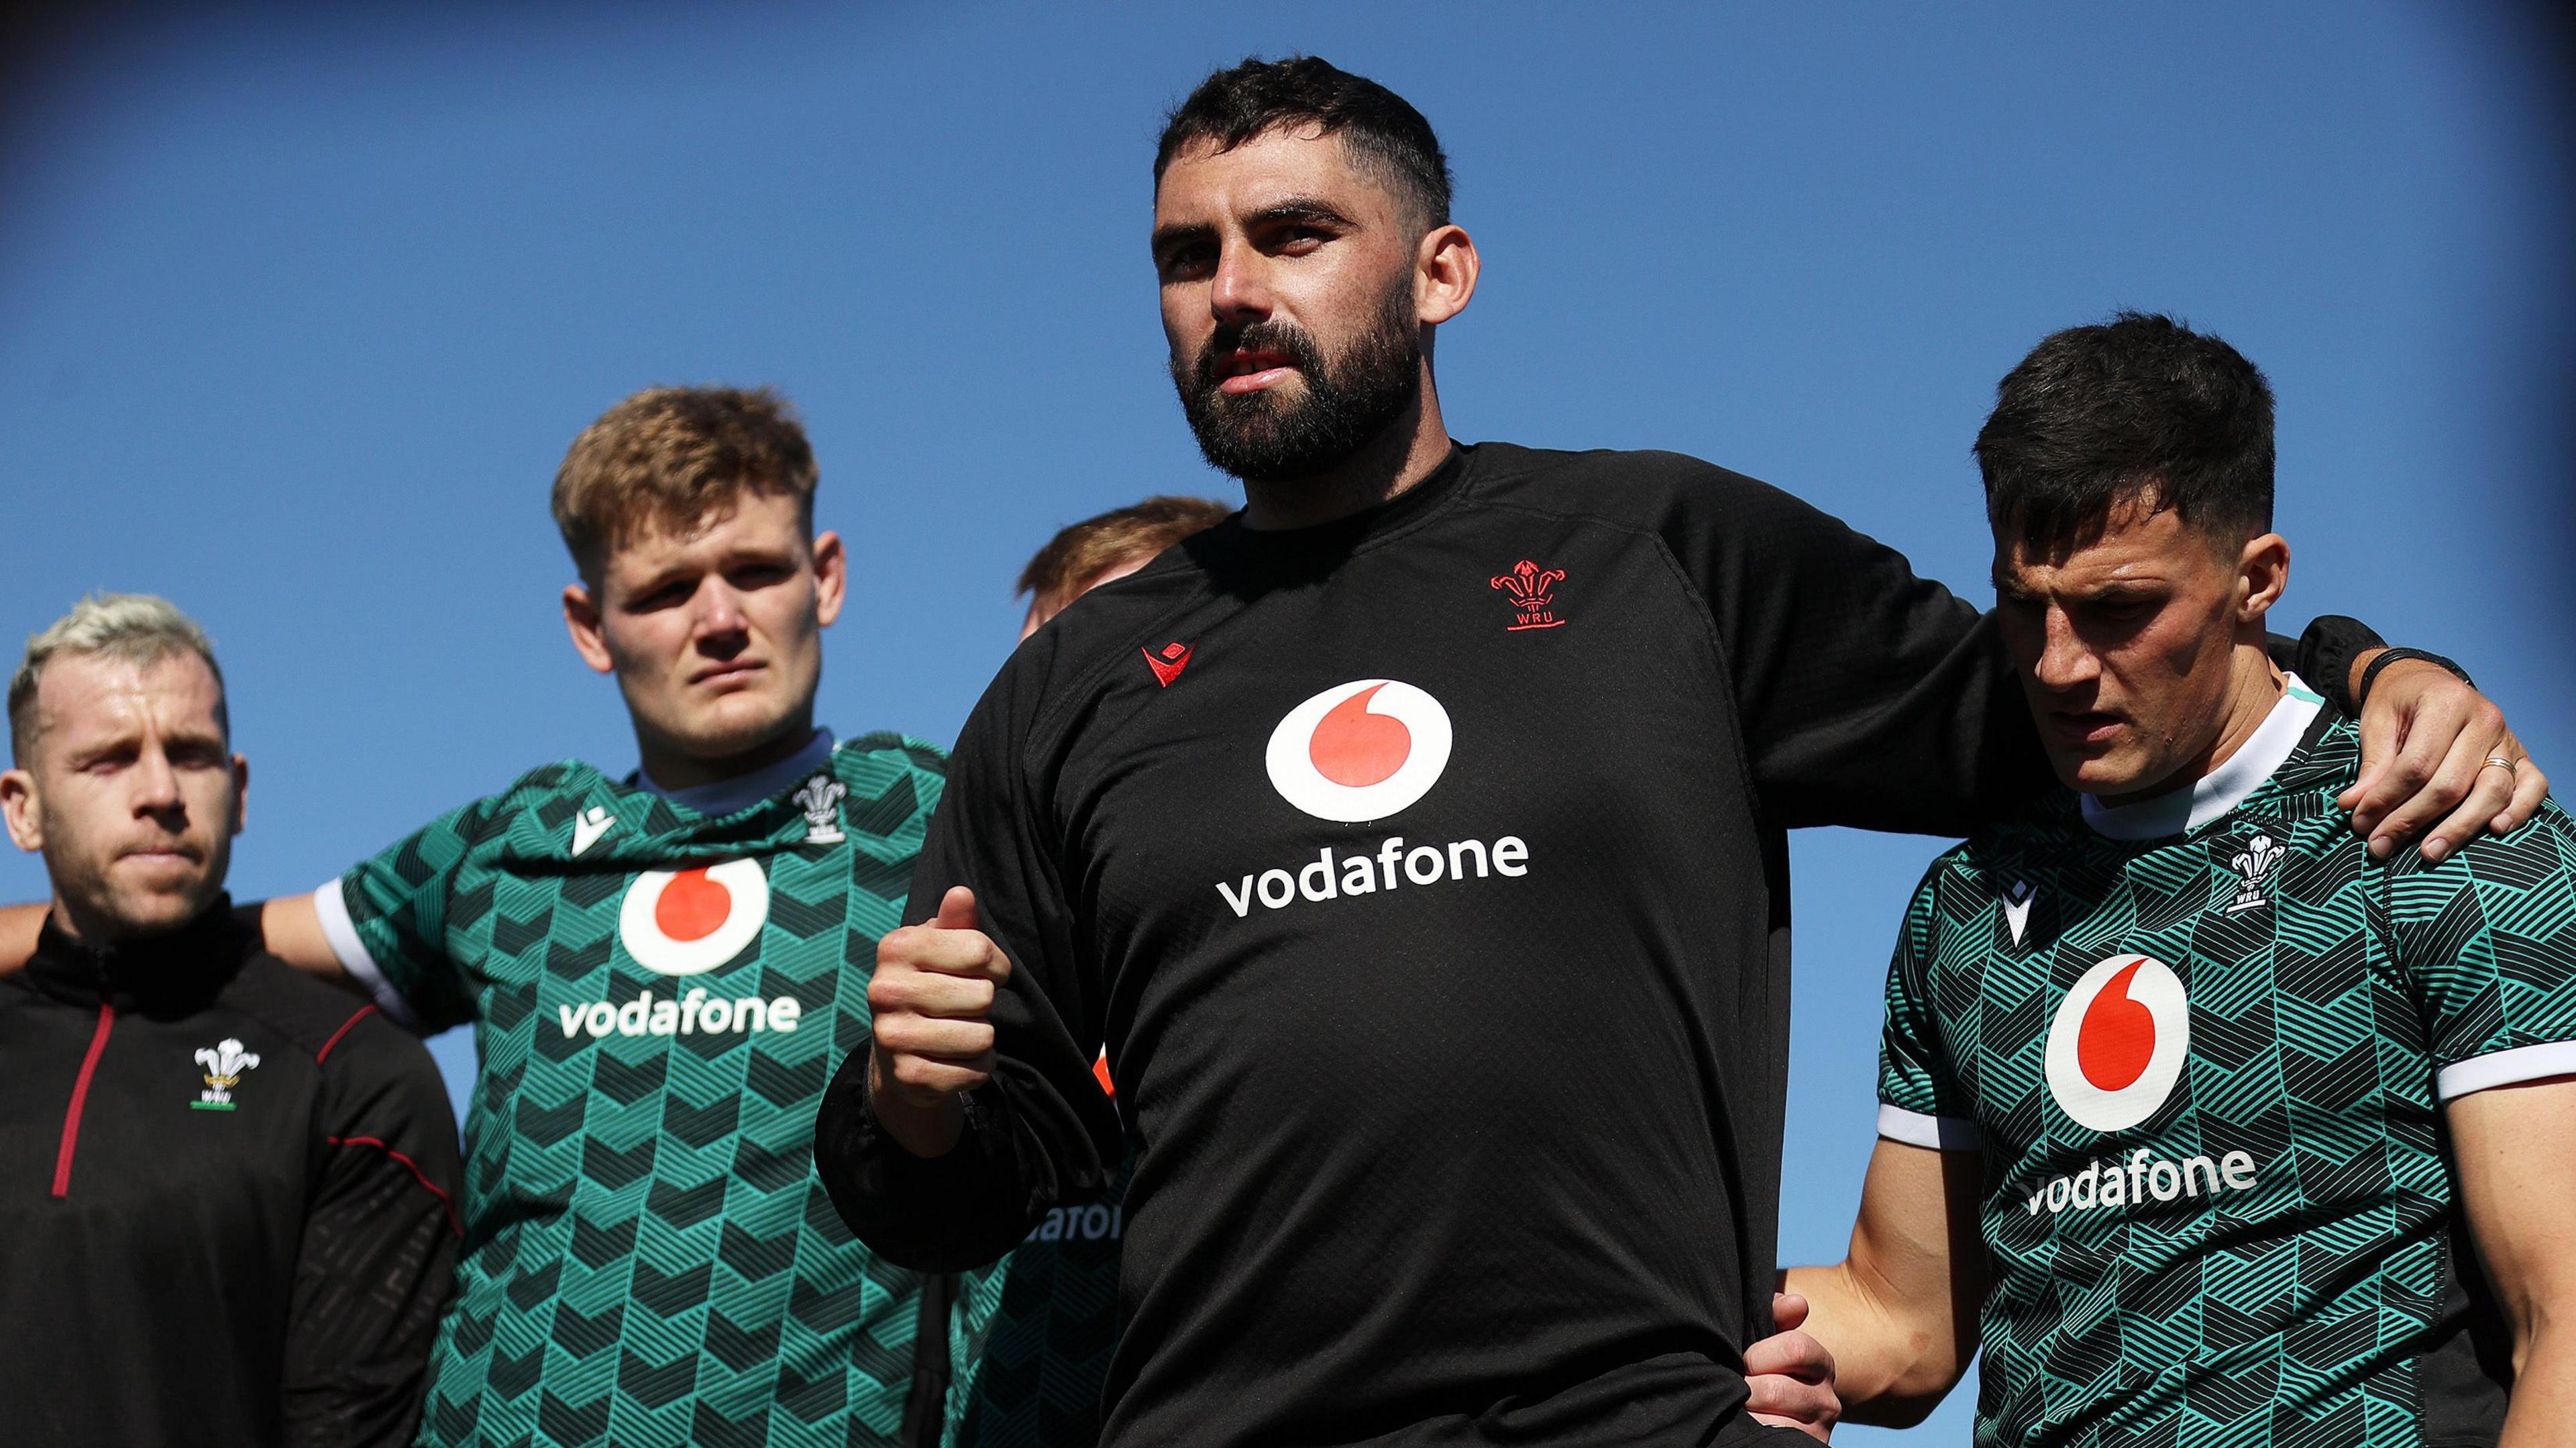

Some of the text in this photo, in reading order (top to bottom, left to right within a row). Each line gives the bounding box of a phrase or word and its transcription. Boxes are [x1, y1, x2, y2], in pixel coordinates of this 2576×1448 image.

[1517, 611, 1553, 624] WRU
[1216, 836, 1529, 917] vodafone
[2237, 889, 2259, 904] WRU
[559, 987, 801, 1039] vodafone
[2017, 1149, 2257, 1216] vodafone
